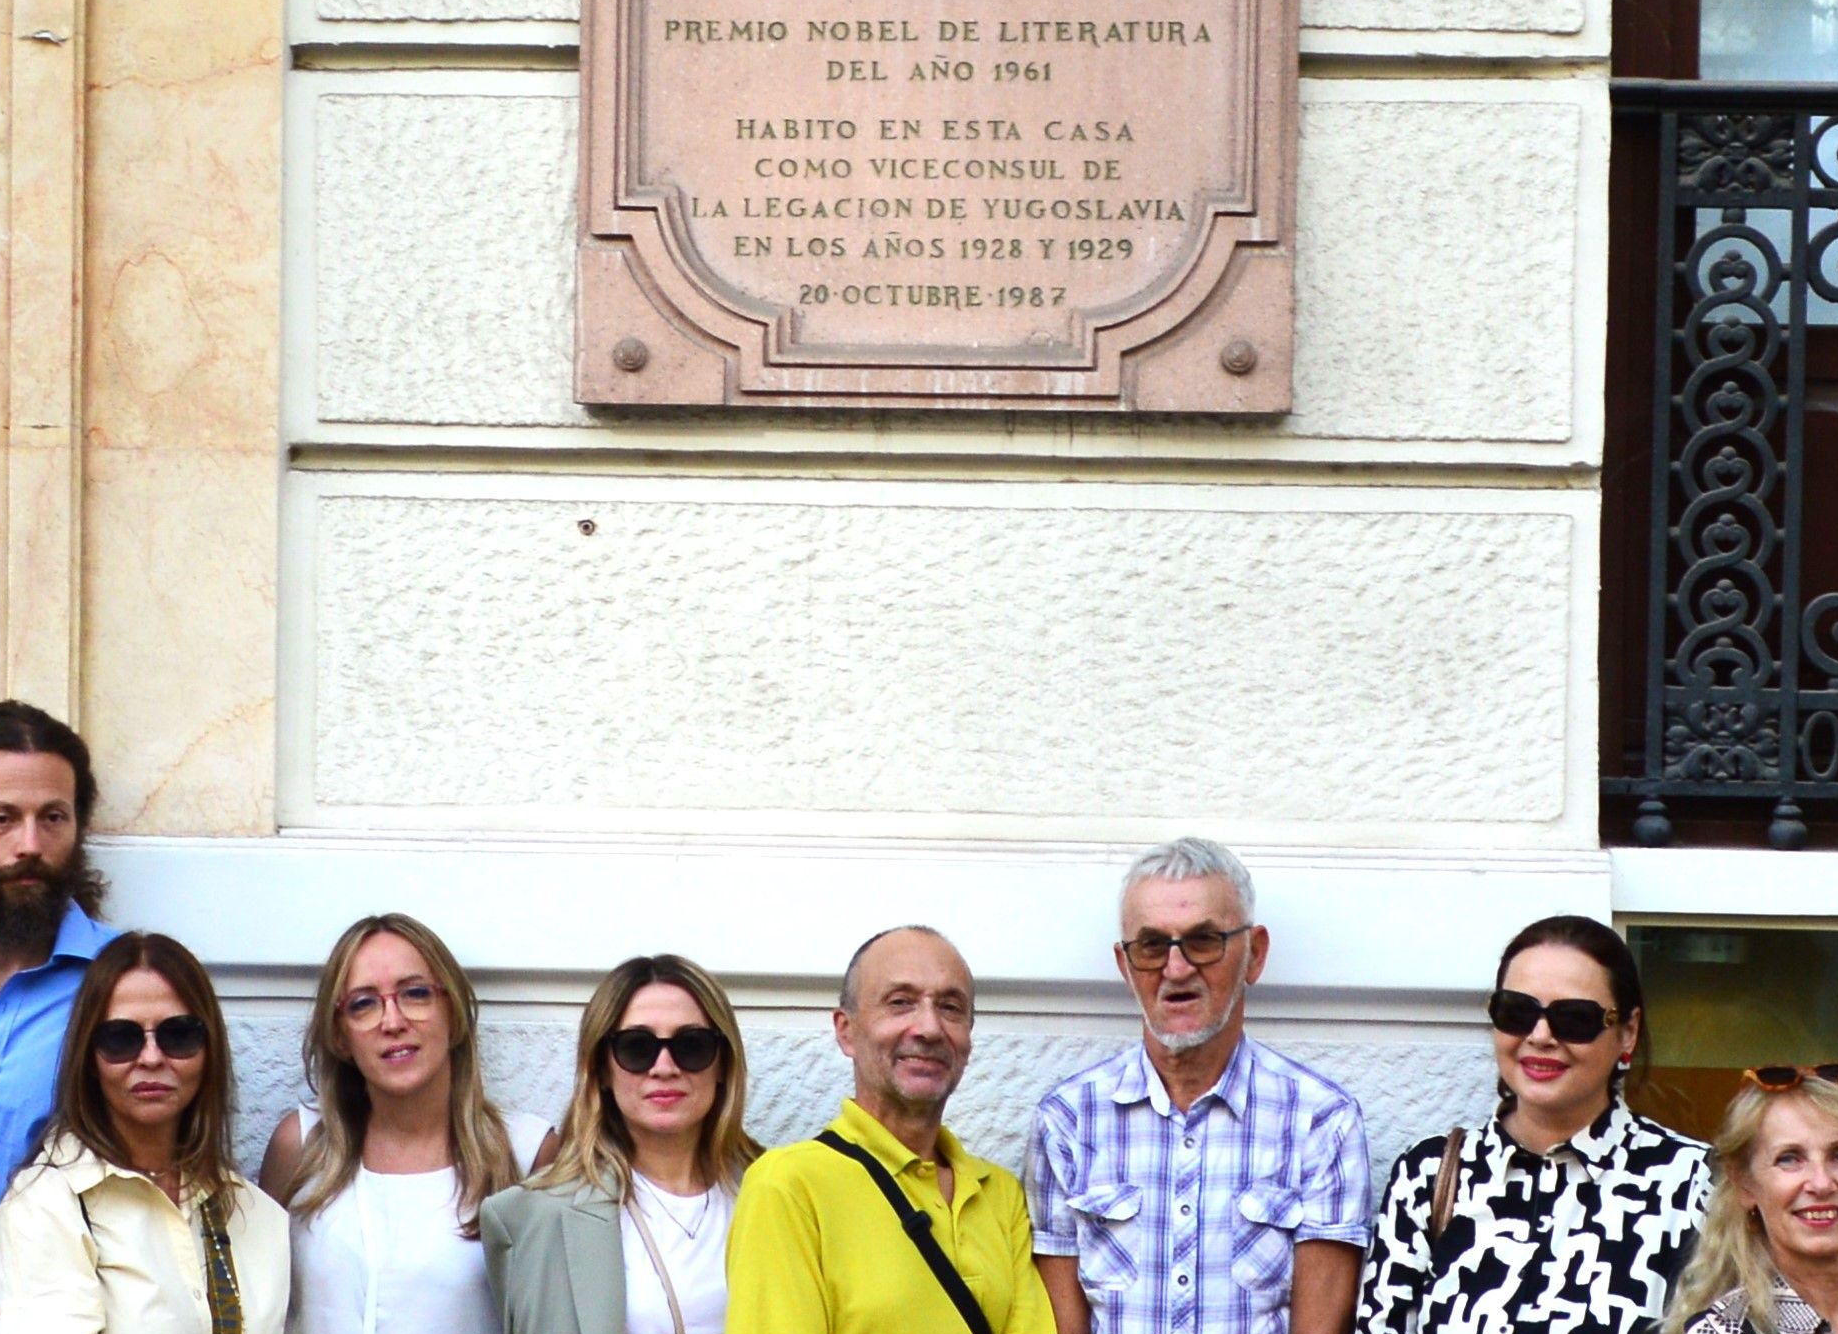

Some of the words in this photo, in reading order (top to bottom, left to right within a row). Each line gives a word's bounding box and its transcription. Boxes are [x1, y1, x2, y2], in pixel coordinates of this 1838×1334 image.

[665, 19, 789, 45] PREMIO
[806, 20, 919, 42] NOBEL
[938, 20, 980, 42] DE
[998, 20, 1211, 48] LITERATURA
[826, 60, 889, 82] DEL
[908, 54, 974, 82] AÑO
[994, 60, 1052, 82] 1961
[736, 118, 857, 140] HABITO
[879, 119, 921, 141] EN
[942, 119, 1022, 141] ESTA
[1043, 120, 1134, 142] CASA
[754, 158, 853, 179] COMO
[869, 158, 1065, 180] VICECONSUL
[1083, 159, 1121, 181] DE
[691, 197, 729, 219] LA
[743, 197, 912, 219] LEGACION
[926, 197, 967, 220] DE
[982, 198, 1186, 222] YUGOSLAVIA
[734, 235, 772, 258] EN
[786, 237, 846, 258] LOS
[862, 231, 945, 259] AÑOS
[960, 238, 1023, 261] 1928
[1038, 237, 1057, 260] Y
[1068, 237, 1134, 261] 1929
